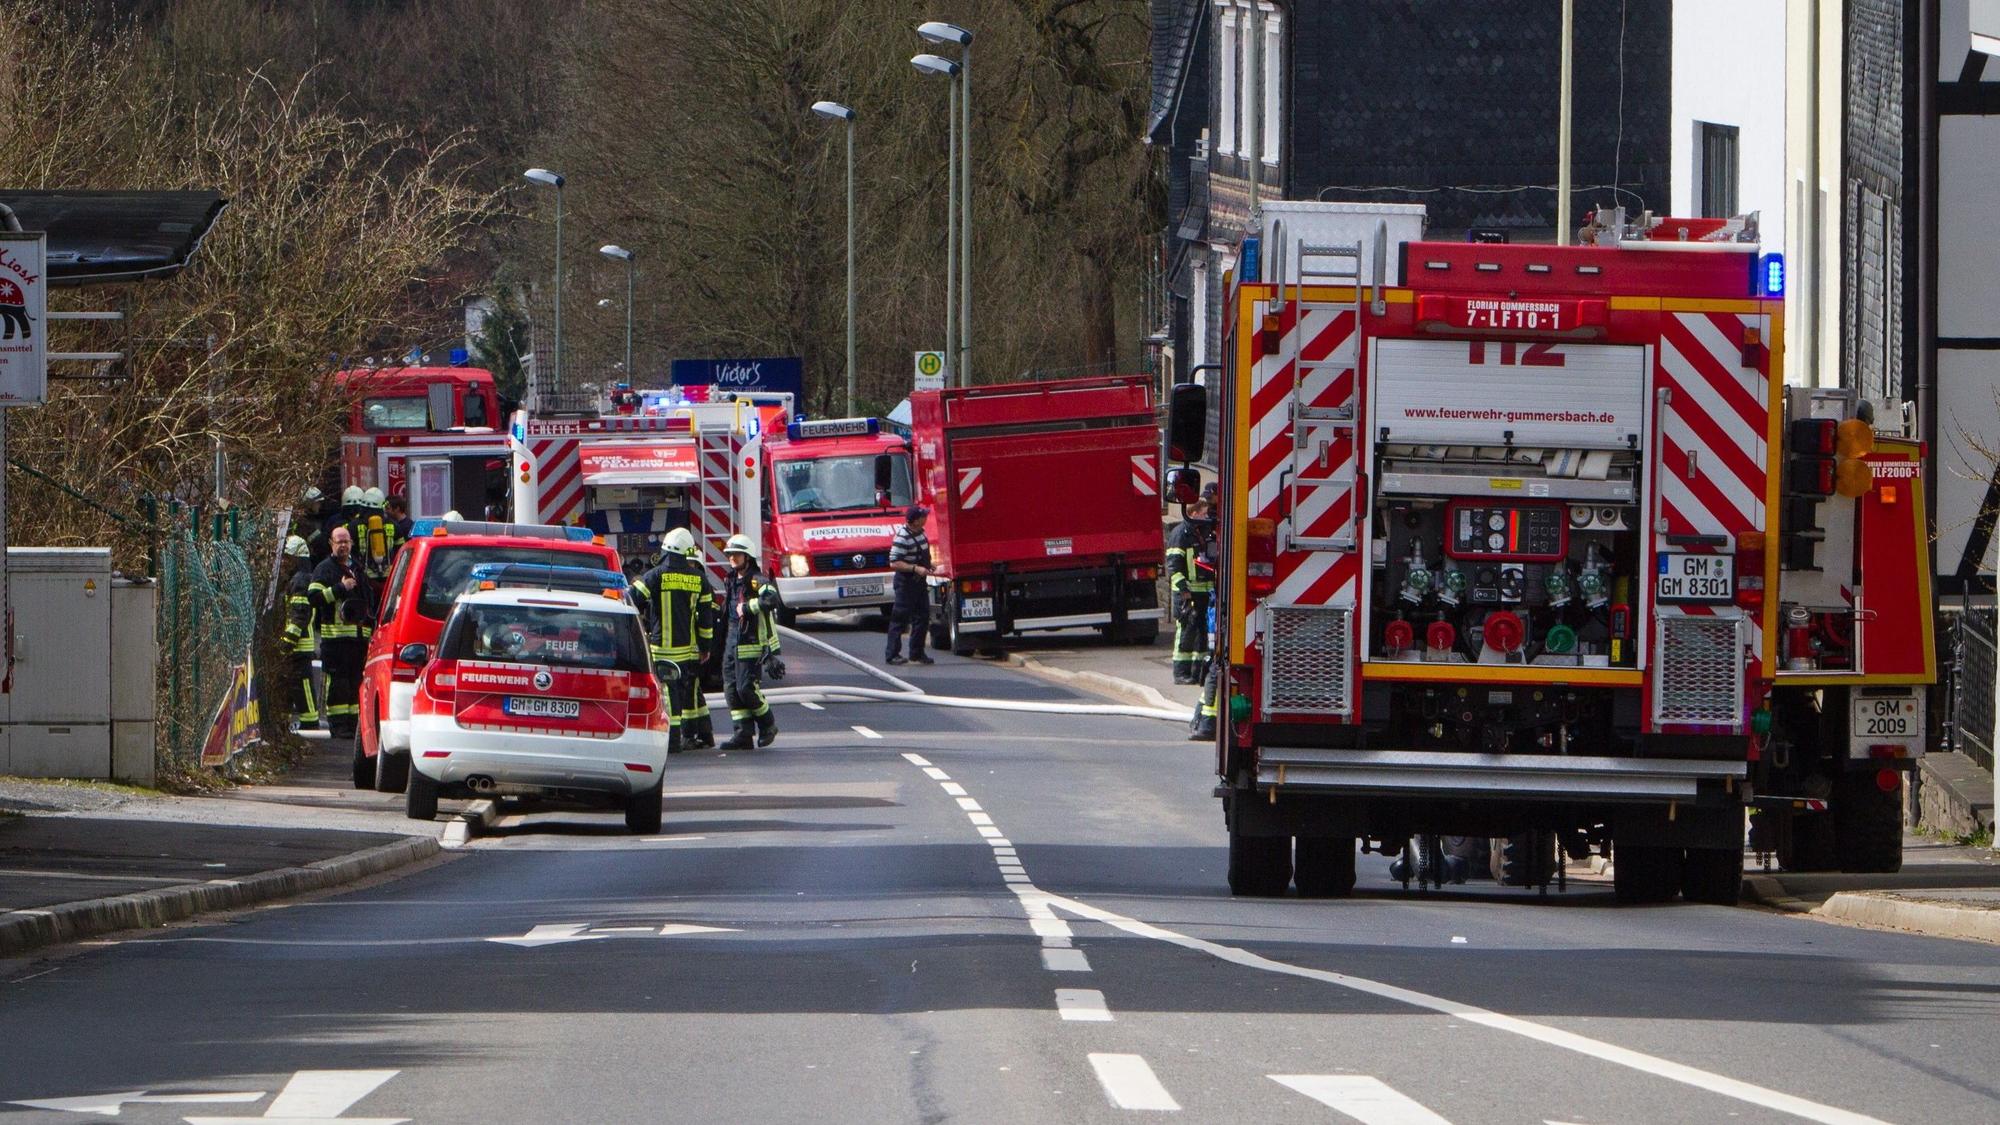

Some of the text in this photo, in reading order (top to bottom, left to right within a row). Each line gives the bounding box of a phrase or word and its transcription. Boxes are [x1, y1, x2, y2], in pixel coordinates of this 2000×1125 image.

[1467, 300, 1560, 313] FLORIAN GUMMERSBACH
[716, 361, 761, 386] Victor's
[1404, 408, 1615, 424] www.feuerwehr-gummersbach.de
[802, 422, 867, 436] FEUERWEHR
[811, 527, 881, 536] EINSATZLEITUNG
[1684, 558, 1708, 576] GM
[1661, 578, 1729, 596] GM 8301
[461, 673, 529, 686] FEUERWEHR
[511, 698, 578, 714] GM GM 8309
[1875, 701, 1900, 716] GM
[1867, 718, 1906, 734] 2009
